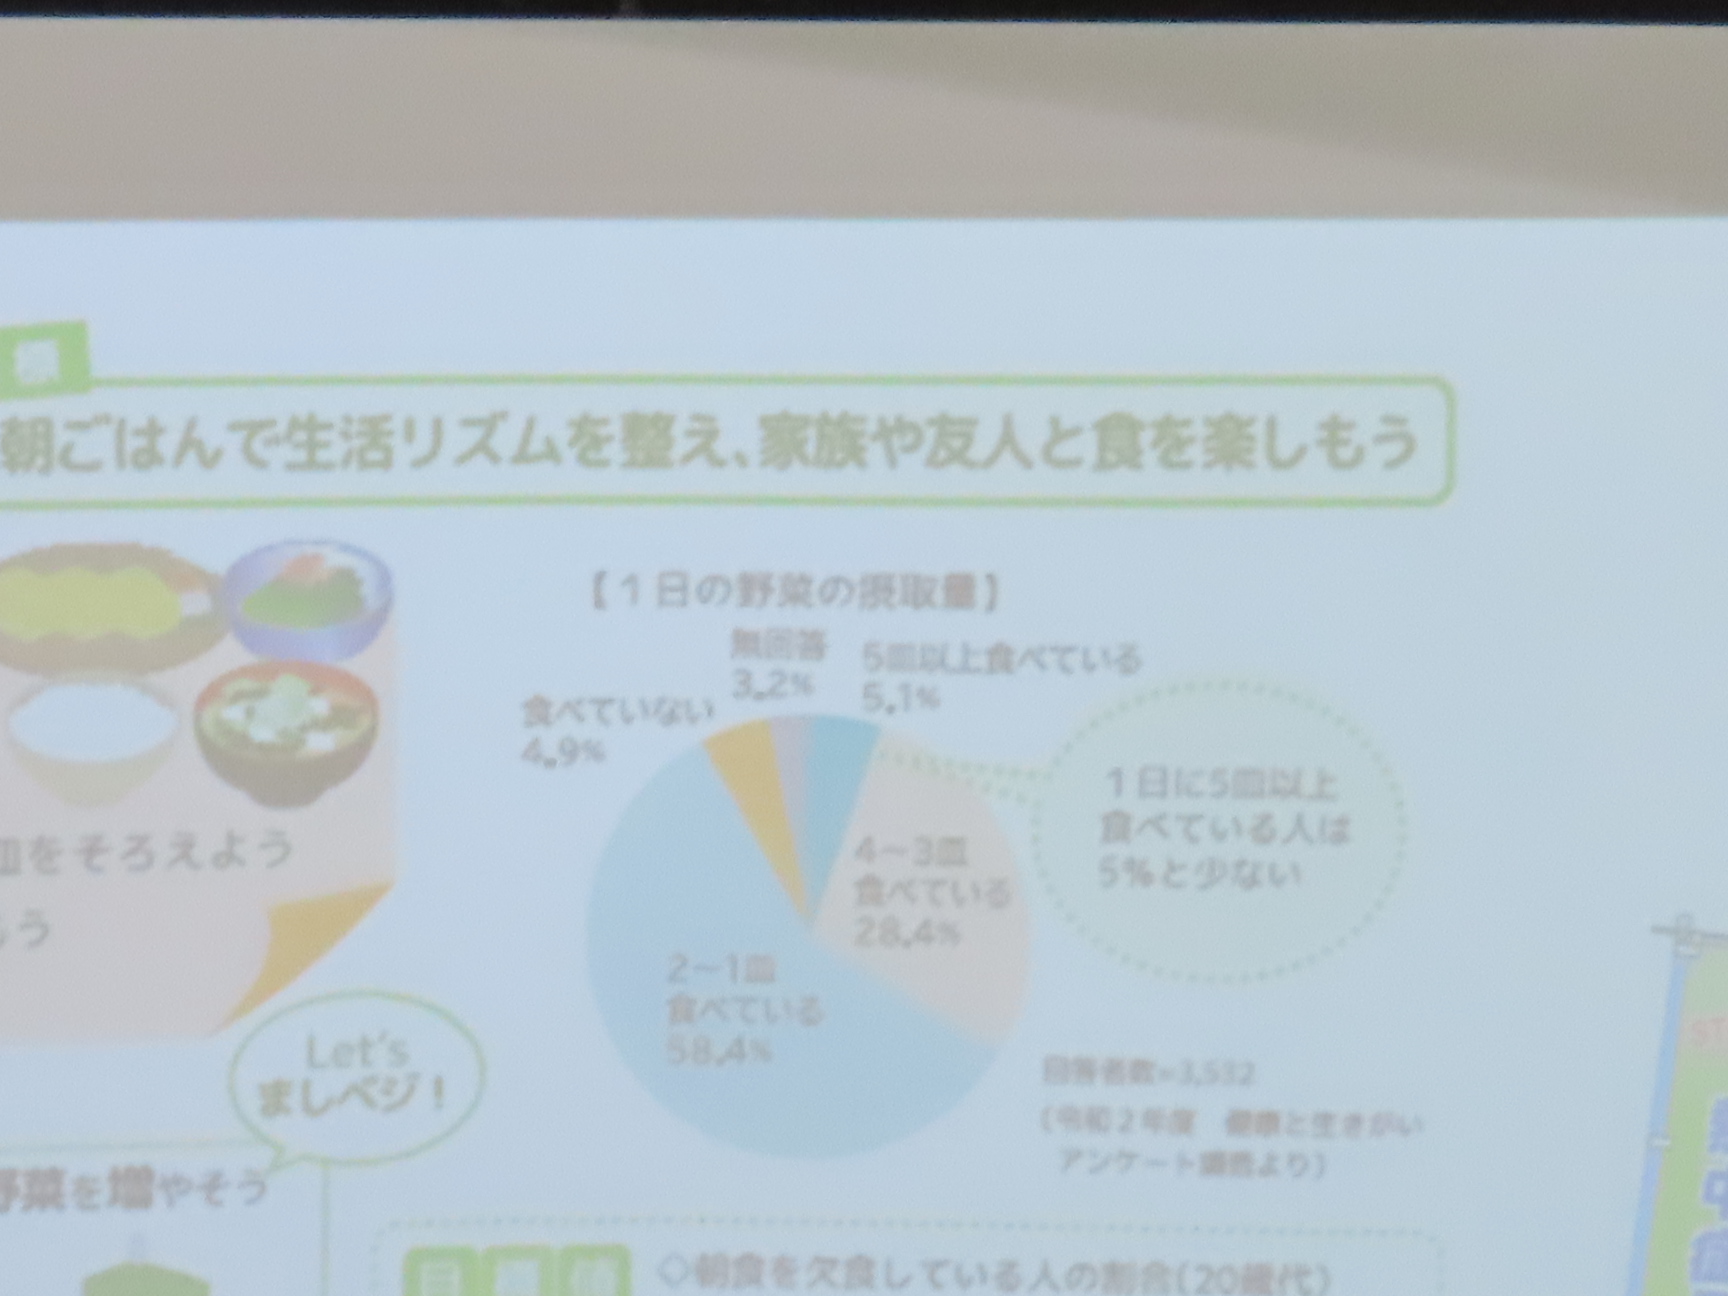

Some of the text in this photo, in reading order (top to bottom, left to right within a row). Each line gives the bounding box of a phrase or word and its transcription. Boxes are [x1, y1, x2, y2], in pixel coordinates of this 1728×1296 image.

[0, 410, 1419, 475] 朝ごはんで生活リズムを整え、家族や友人と食を楽しもう
[731, 669, 814, 701] 3.2%
[861, 682, 942, 715] 5.1%
[520, 694, 716, 726] 食べていない
[520, 736, 606, 769] 4.9%
[1099, 808, 1352, 847] 食べている人は
[1098, 855, 1303, 892] 5%と少ない
[853, 874, 1011, 909] 食べている
[852, 916, 962, 949] 28.4%
[664, 993, 826, 1028] 食べている
[304, 1030, 411, 1072] Let's
[664, 1034, 774, 1066] 58.4%
